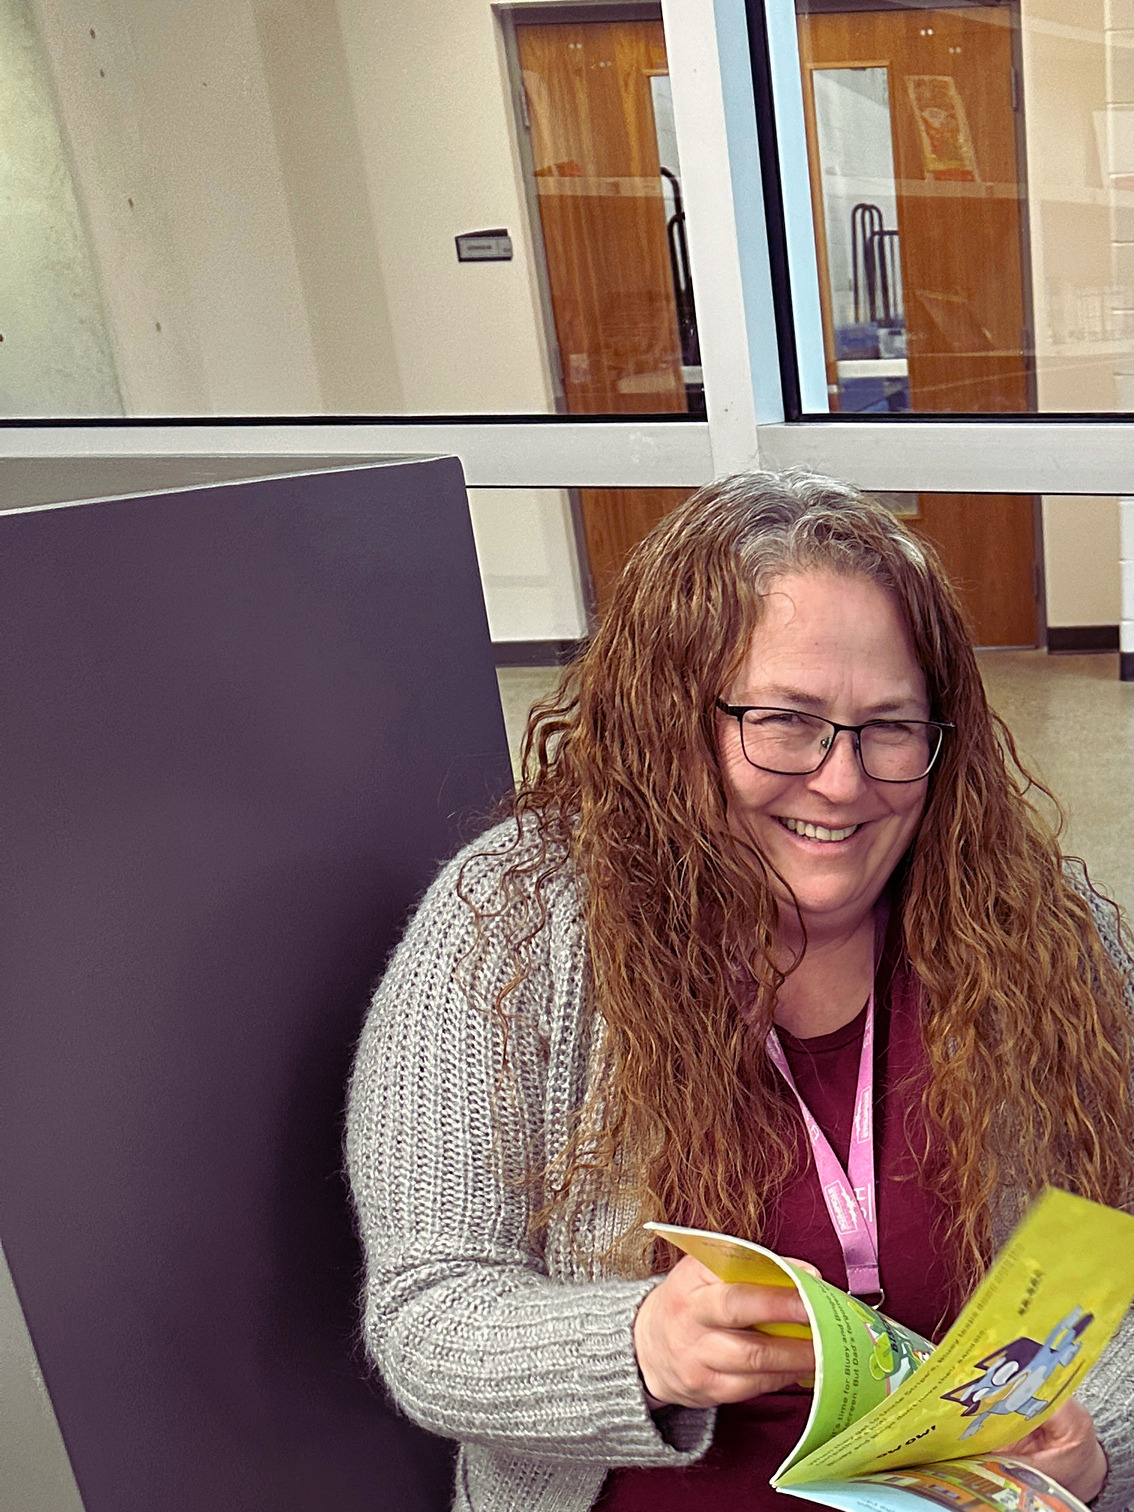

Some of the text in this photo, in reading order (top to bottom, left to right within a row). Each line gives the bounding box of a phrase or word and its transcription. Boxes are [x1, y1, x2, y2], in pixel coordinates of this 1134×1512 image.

[837, 1323, 847, 1343] and
[849, 1336, 858, 1366] Dad's
[842, 1377, 851, 1394] for
[836, 1396, 848, 1420] time
